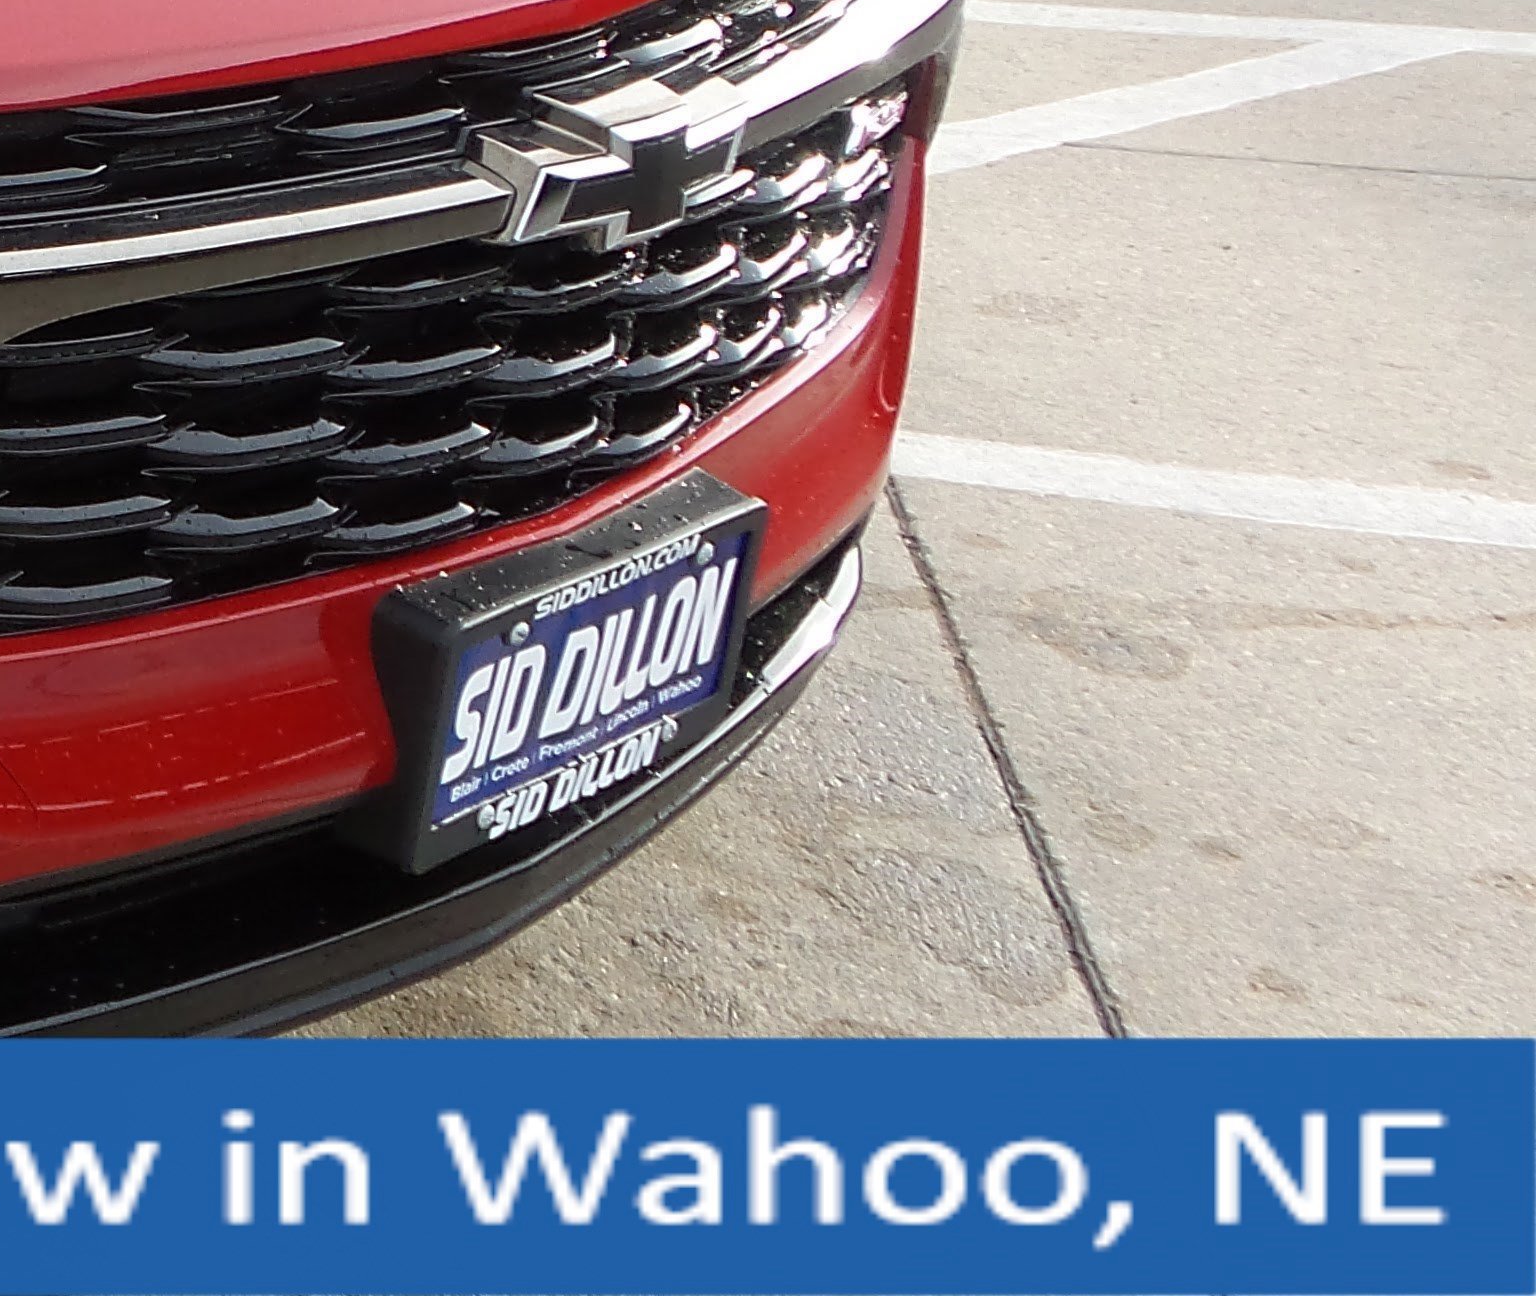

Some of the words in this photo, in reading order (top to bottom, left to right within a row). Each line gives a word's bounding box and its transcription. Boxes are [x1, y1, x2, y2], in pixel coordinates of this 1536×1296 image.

[533, 533, 702, 620] SIDDILLON.COM
[440, 644, 546, 785] SID
[538, 557, 738, 739] DILLON
[450, 776, 481, 804] Blair
[490, 756, 530, 783] Crete
[538, 726, 599, 762] Fremont
[658, 675, 704, 705] Wahoo
[488, 779, 549, 841] SID
[549, 725, 664, 813] DILLON
